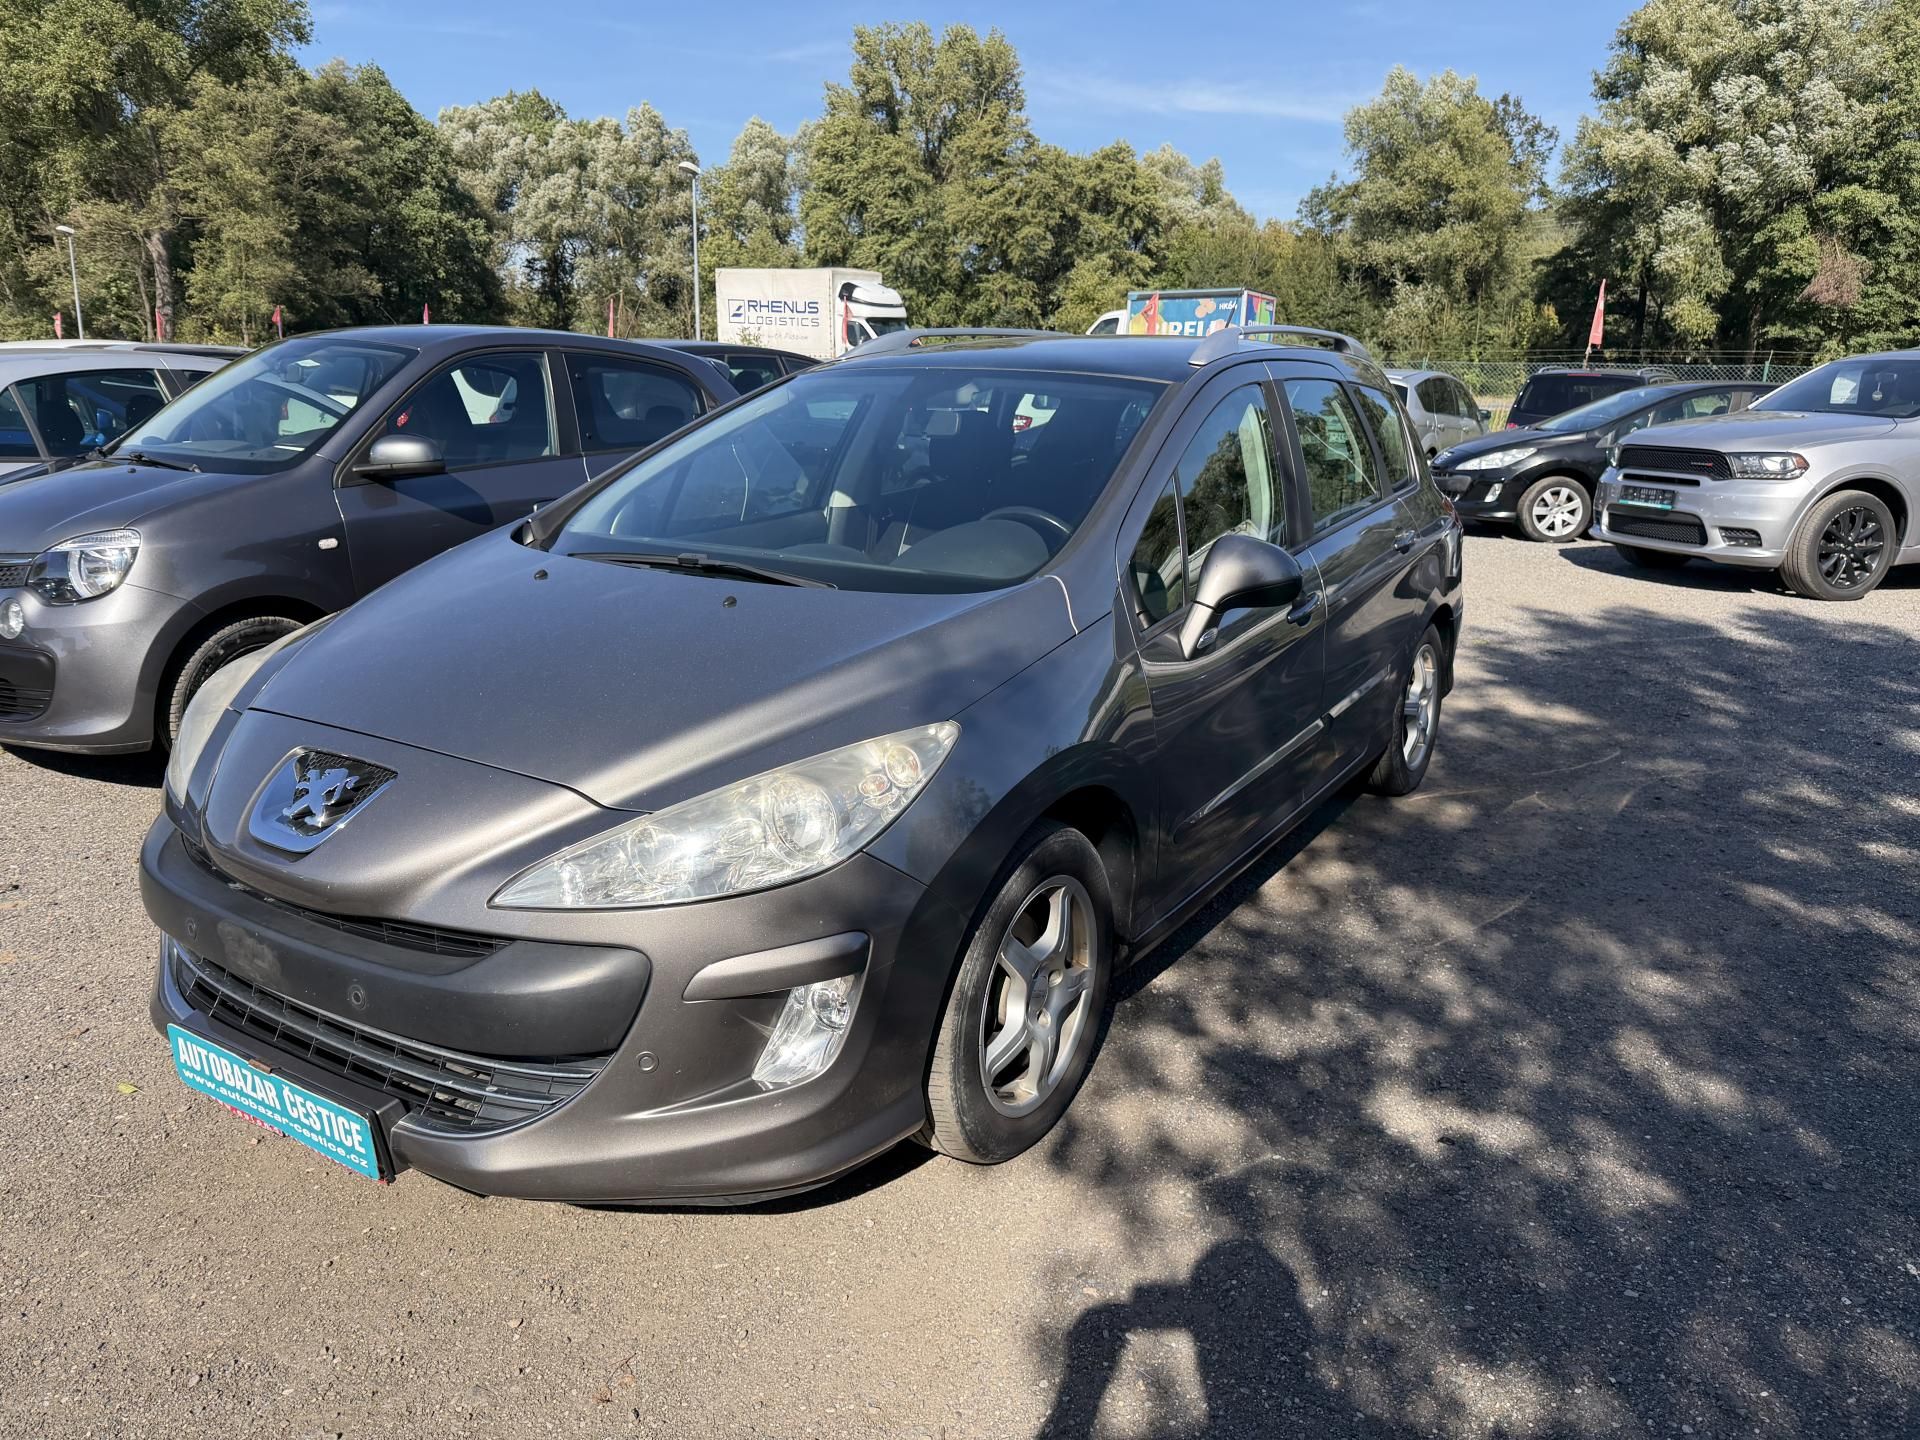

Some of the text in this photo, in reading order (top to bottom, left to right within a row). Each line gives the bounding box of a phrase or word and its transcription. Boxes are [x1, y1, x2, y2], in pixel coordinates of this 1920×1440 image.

[747, 299, 819, 314] RHENUS
[747, 315, 820, 327] LOGISTICS
[177, 1036, 281, 1111] AUTOBAZAR
[282, 1083, 366, 1154] ČESTICE
[182, 1068, 369, 1168] www.autobazar-cestice.cz
